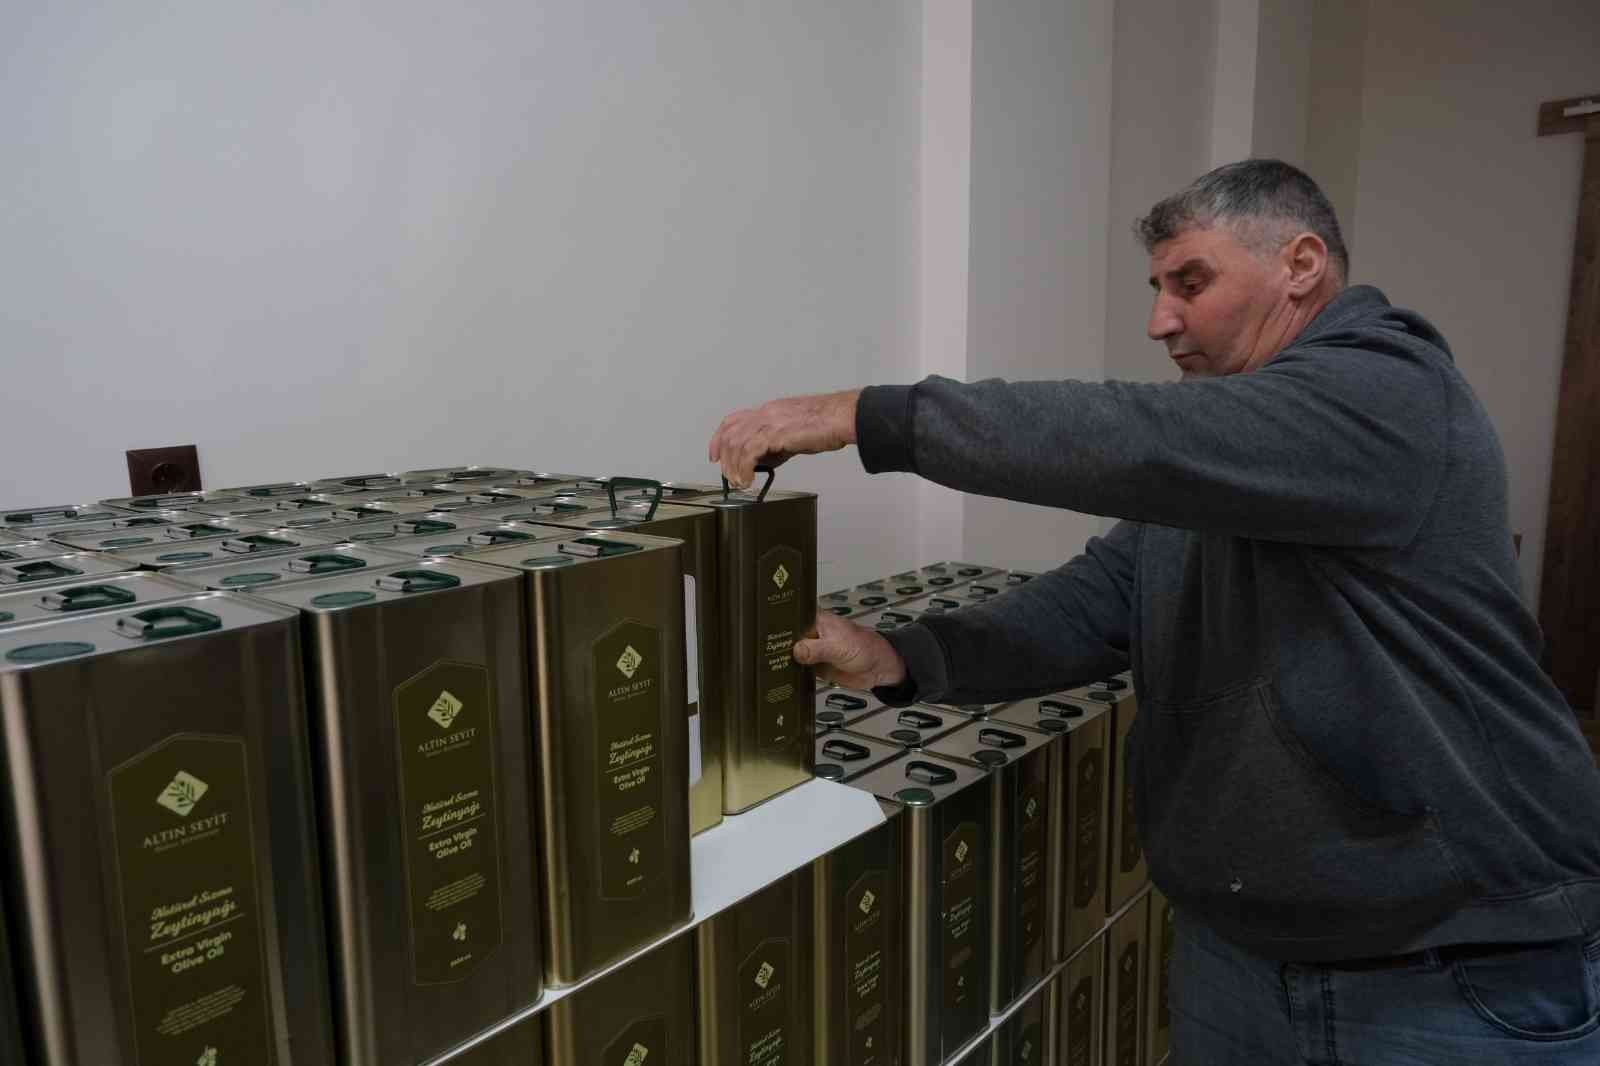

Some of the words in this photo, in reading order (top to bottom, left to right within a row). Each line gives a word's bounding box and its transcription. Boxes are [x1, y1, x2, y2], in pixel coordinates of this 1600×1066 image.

[416, 736, 447, 753] ALTIN
[143, 825, 187, 849] ALTIN
[436, 846, 458, 859] Olive
[460, 839, 473, 850] Oil
[161, 946, 195, 965] Extra
[196, 931, 233, 951] Virgin
[171, 955, 205, 974] Olive
[207, 943, 224, 960] Oil
